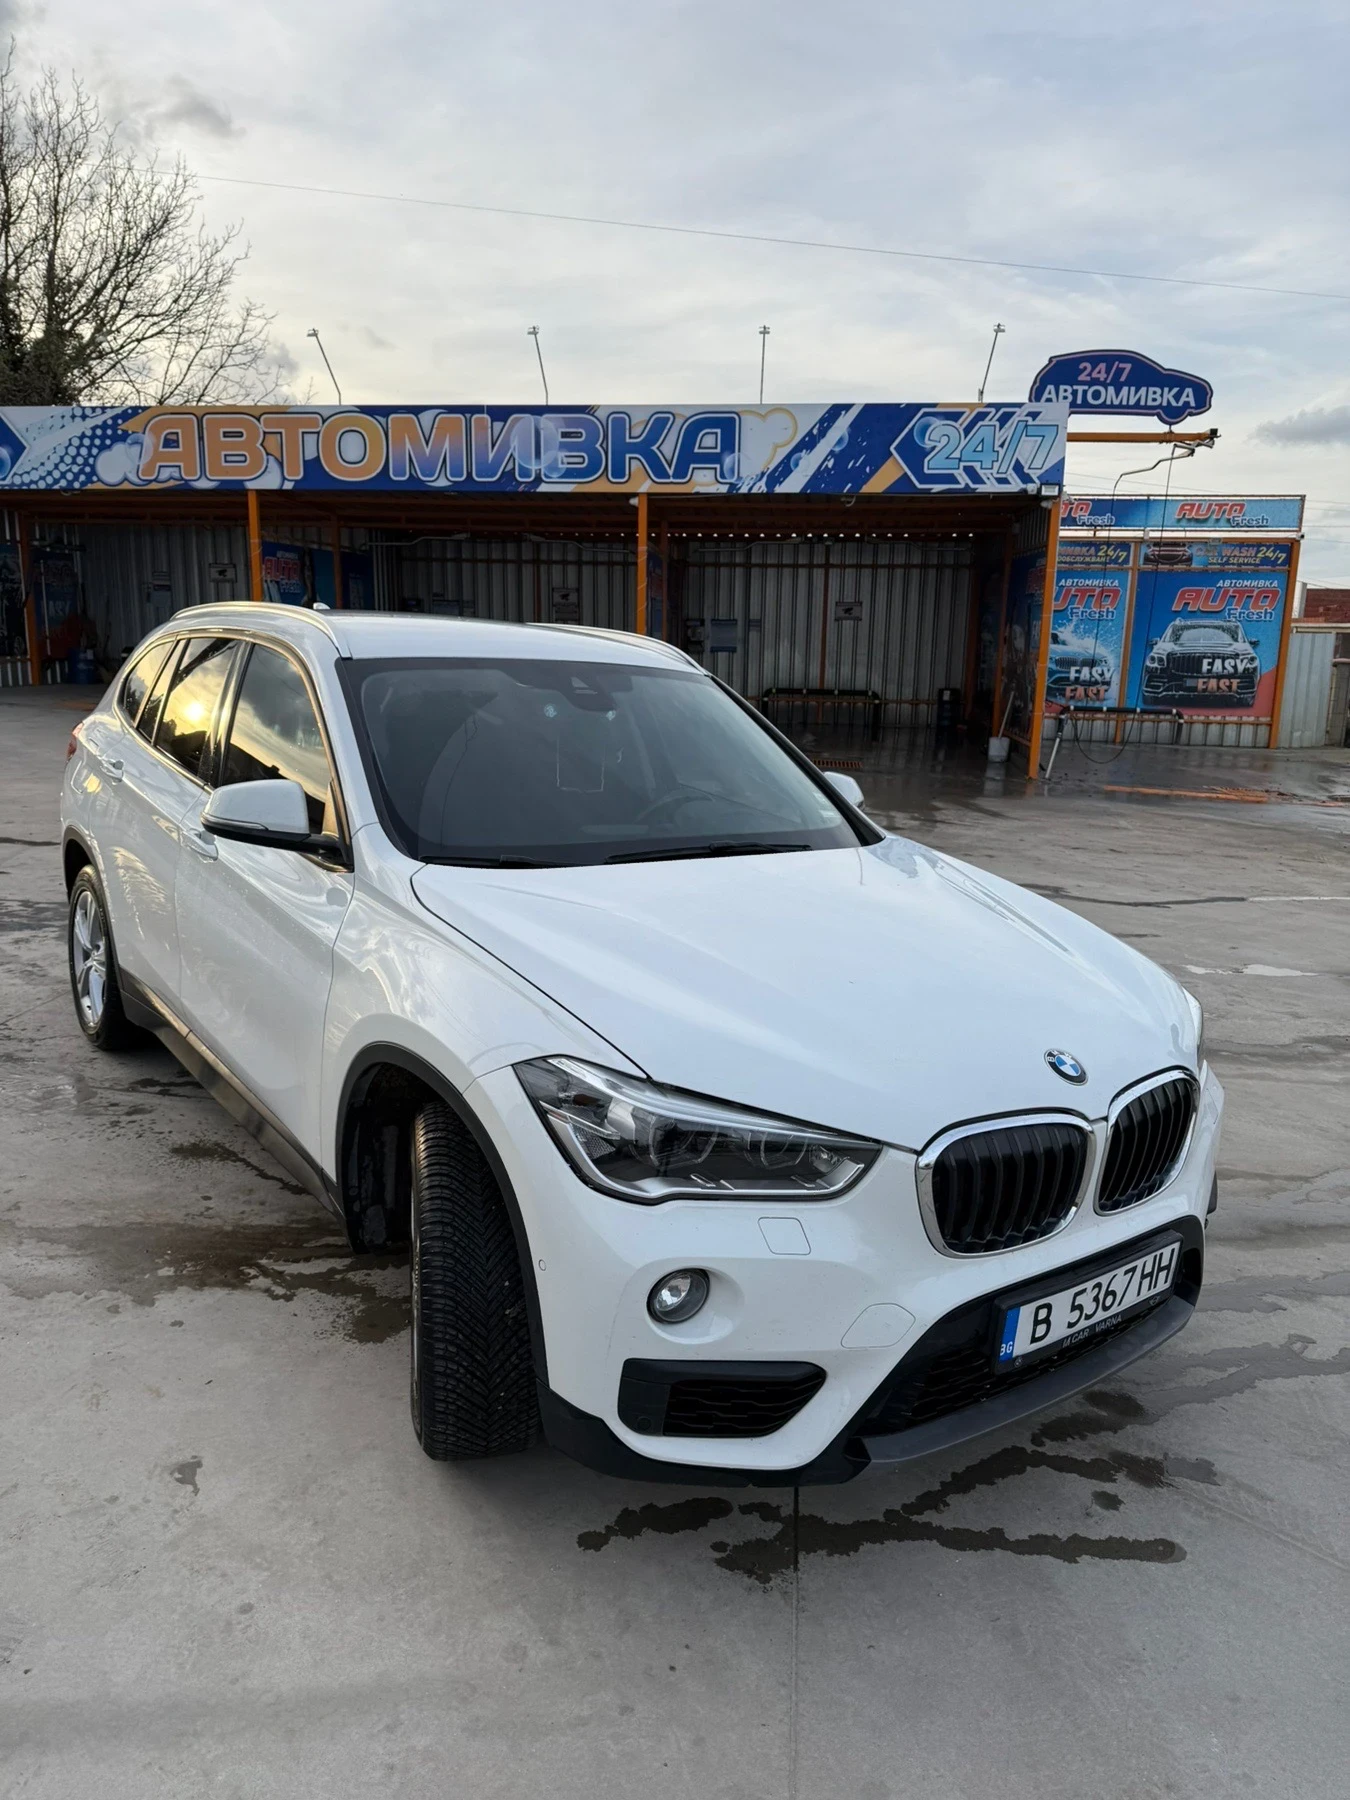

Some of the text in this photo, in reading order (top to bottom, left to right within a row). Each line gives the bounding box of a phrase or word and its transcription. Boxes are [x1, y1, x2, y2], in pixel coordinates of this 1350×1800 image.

[1078, 361, 1132, 384] 24/7
[1040, 384, 1196, 407] АВТОМИВКА
[138, 411, 1060, 484] АВТОМИВКА 24/7
[1175, 501, 1247, 519] AUTO
[1076, 513, 1115, 525] Fresh
[1230, 515, 1269, 527] Fresh
[1208, 556, 1261, 564] SELF SERVICE
[1222, 547, 1257, 557] WASH
[1256, 546, 1287, 564] 24/7
[1059, 578, 1119, 587] АВТОМИВКА
[1216, 579, 1279, 588] АВТОМИВКА
[1172, 587, 1281, 612] AUTO
[1069, 606, 1116, 619] Fresh
[1225, 606, 1275, 621] Fresh
[1030, 1302, 1052, 1346] B
[1066, 1265, 1138, 1330] 5367
